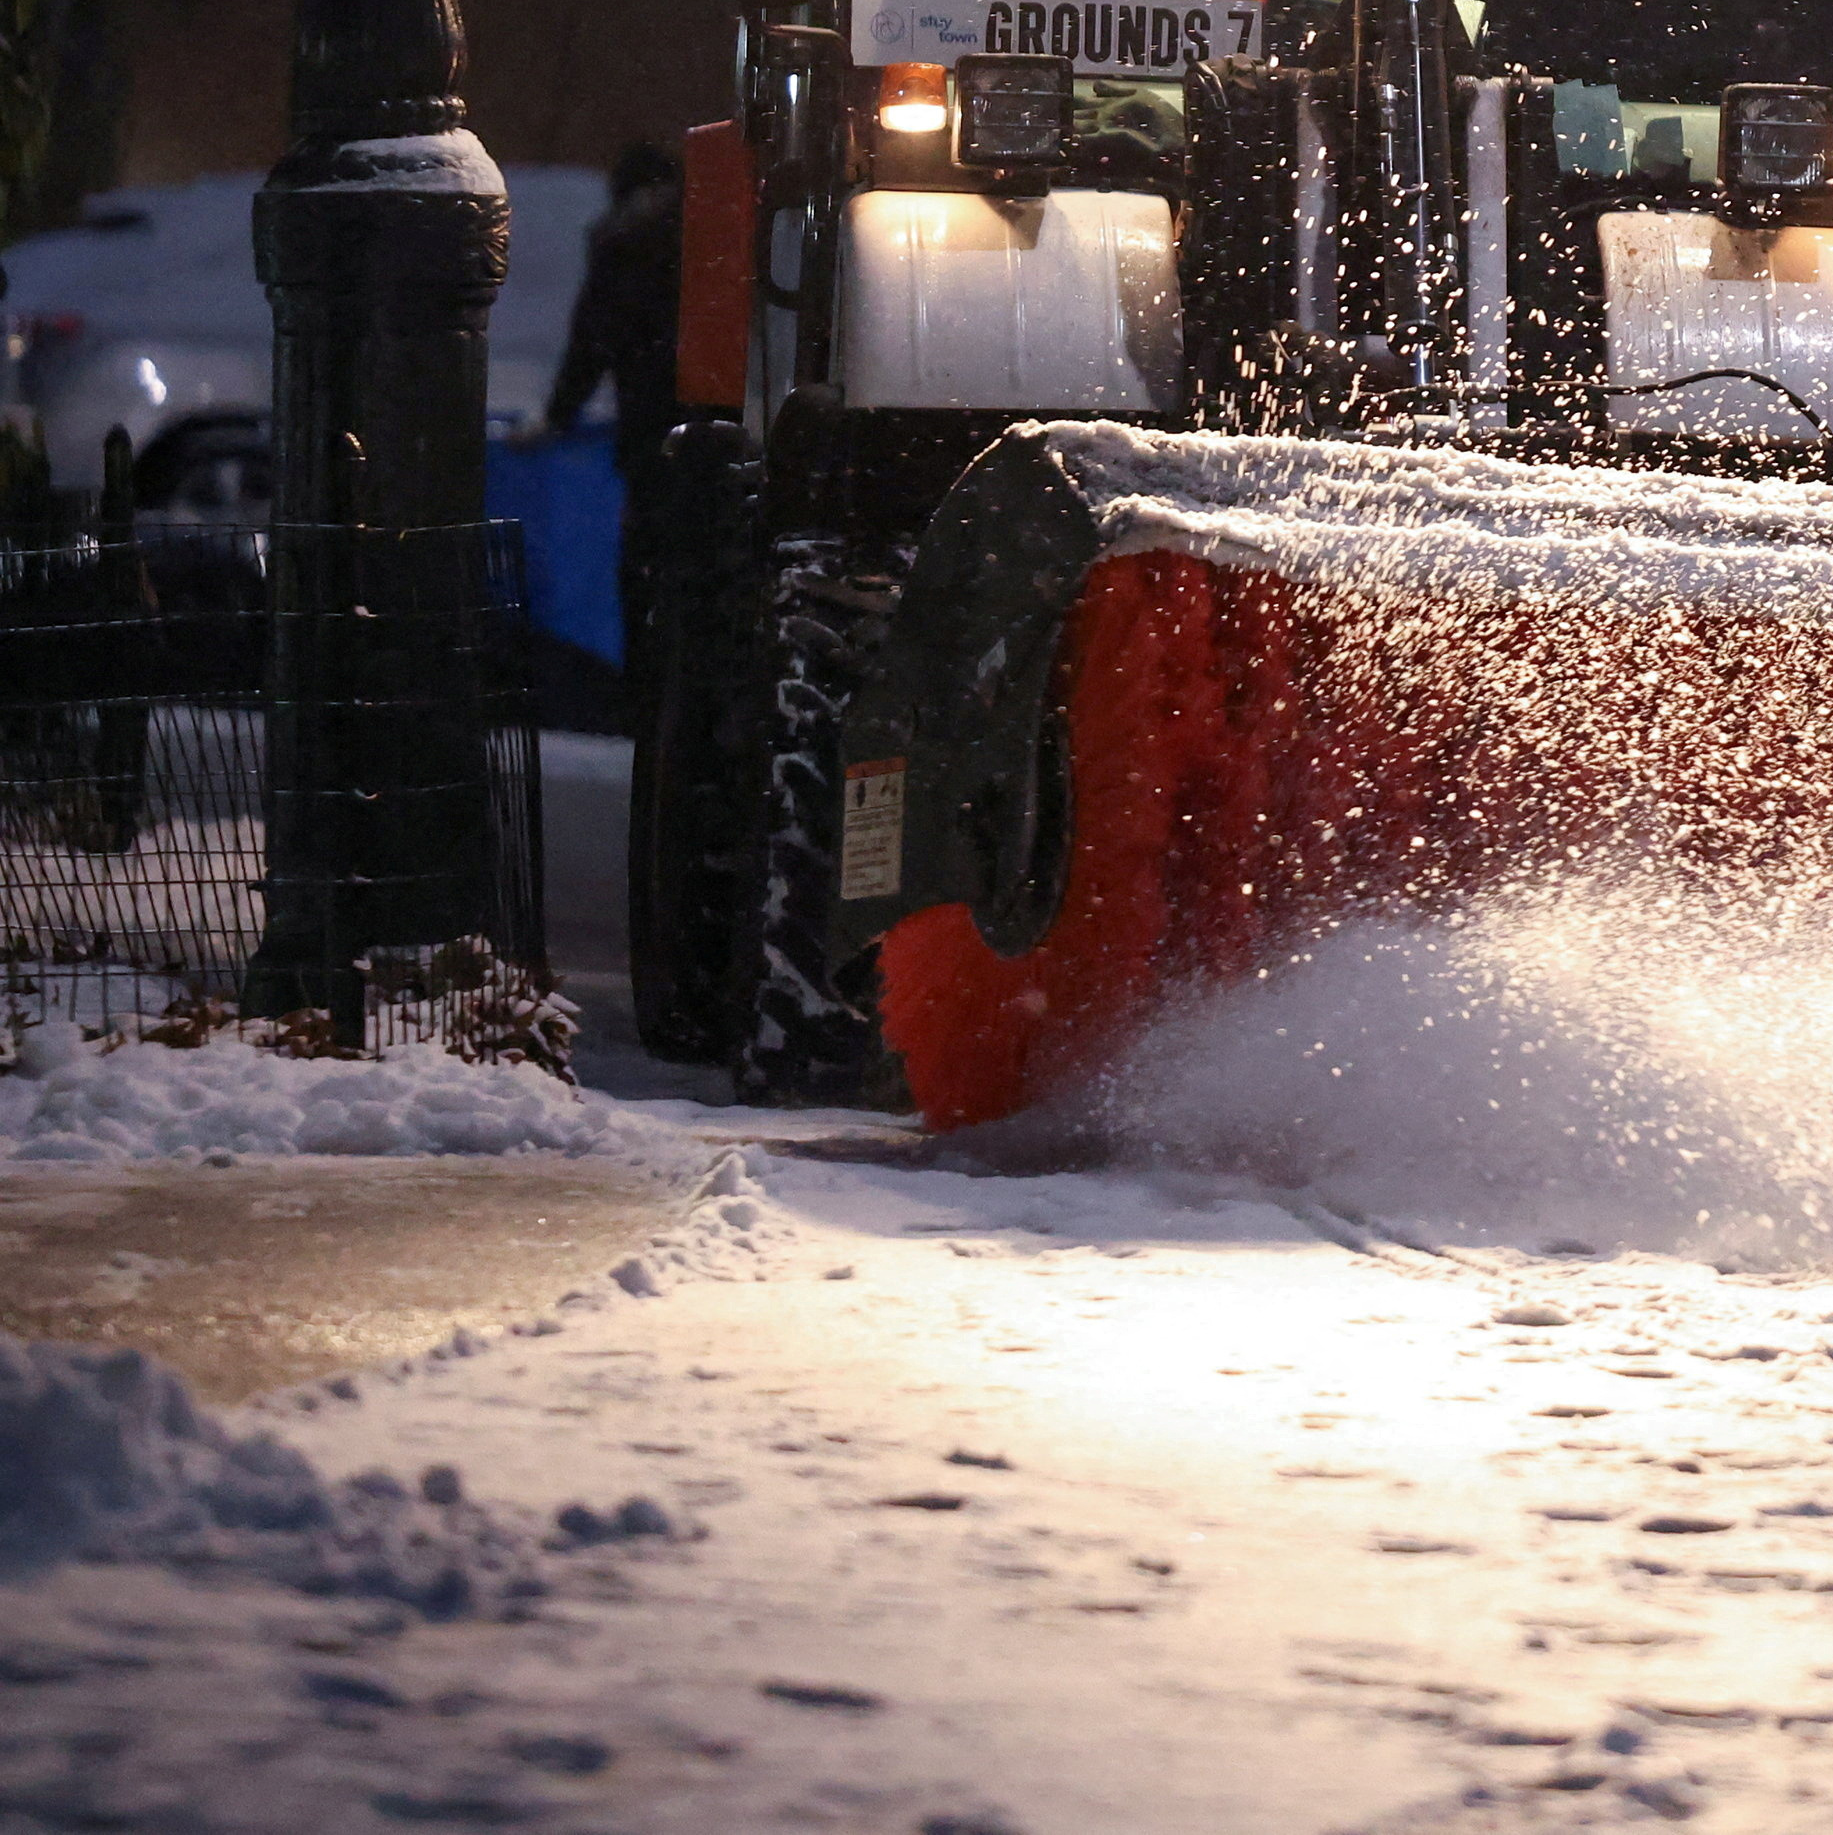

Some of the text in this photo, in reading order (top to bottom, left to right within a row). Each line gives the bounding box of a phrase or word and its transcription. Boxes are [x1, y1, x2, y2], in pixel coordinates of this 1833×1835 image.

[939, 31, 978, 43] town
[985, 1, 1255, 66] GROUNDS 7
